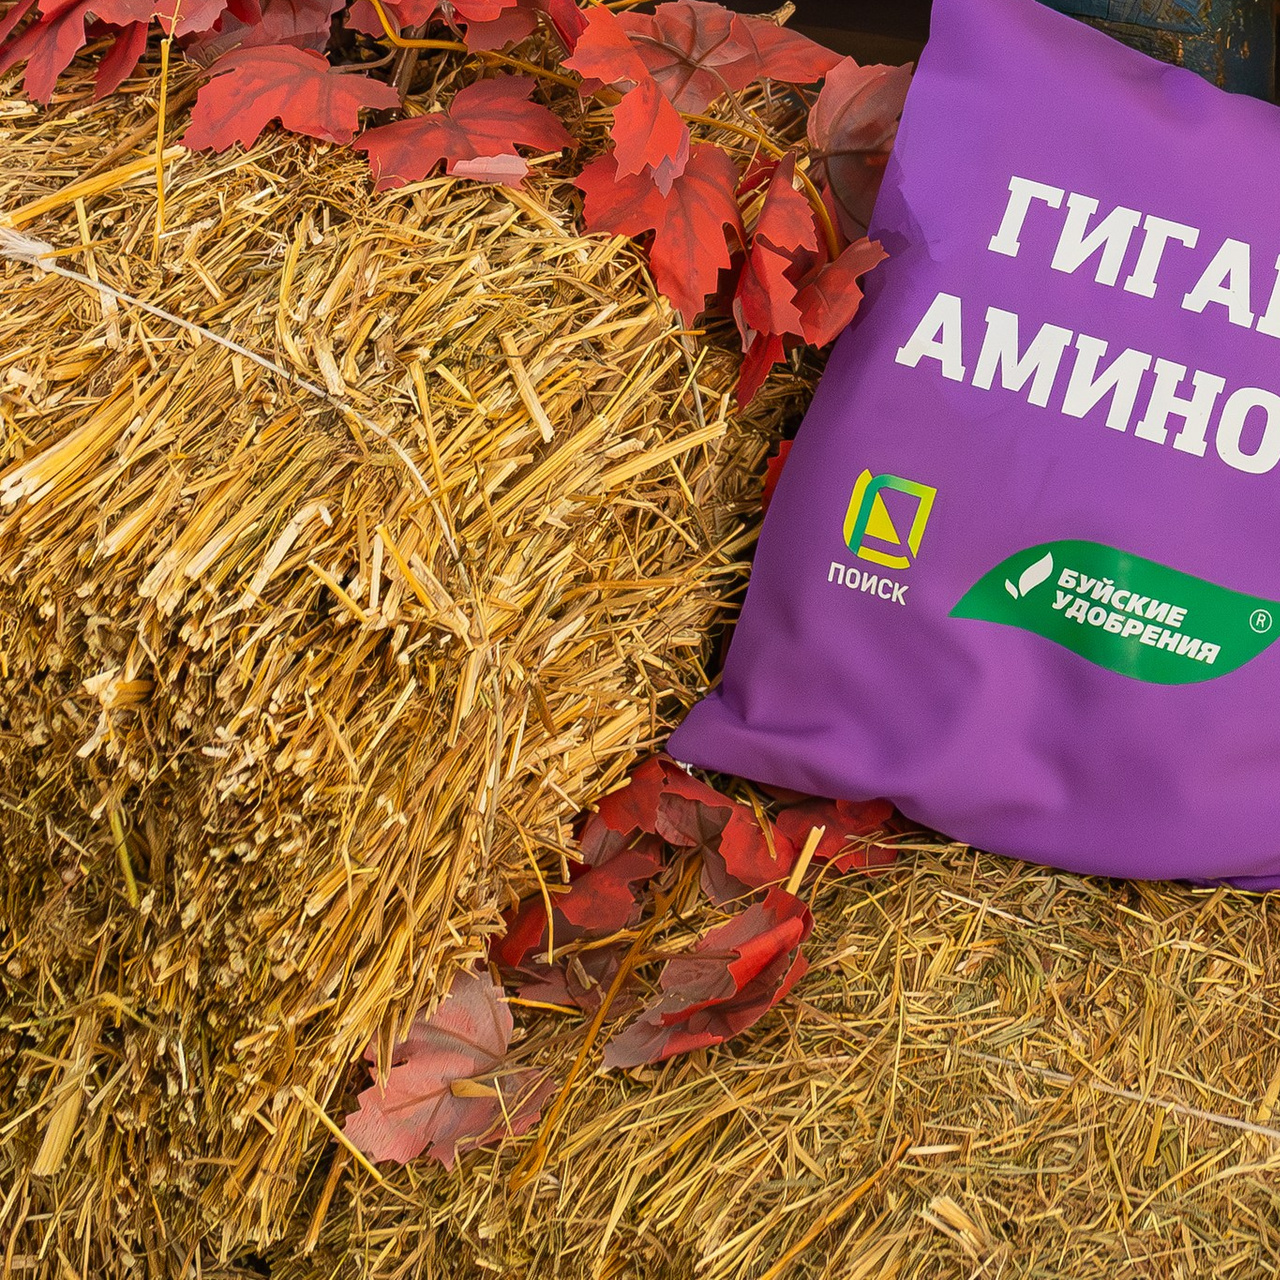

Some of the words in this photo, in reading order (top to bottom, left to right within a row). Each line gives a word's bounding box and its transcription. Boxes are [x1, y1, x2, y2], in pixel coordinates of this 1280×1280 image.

[827, 561, 909, 606] ПОИСК
[1057, 568, 1188, 628] БУЙСКИЕ
[1052, 590, 1221, 664] УДОБРЕНИЯ
